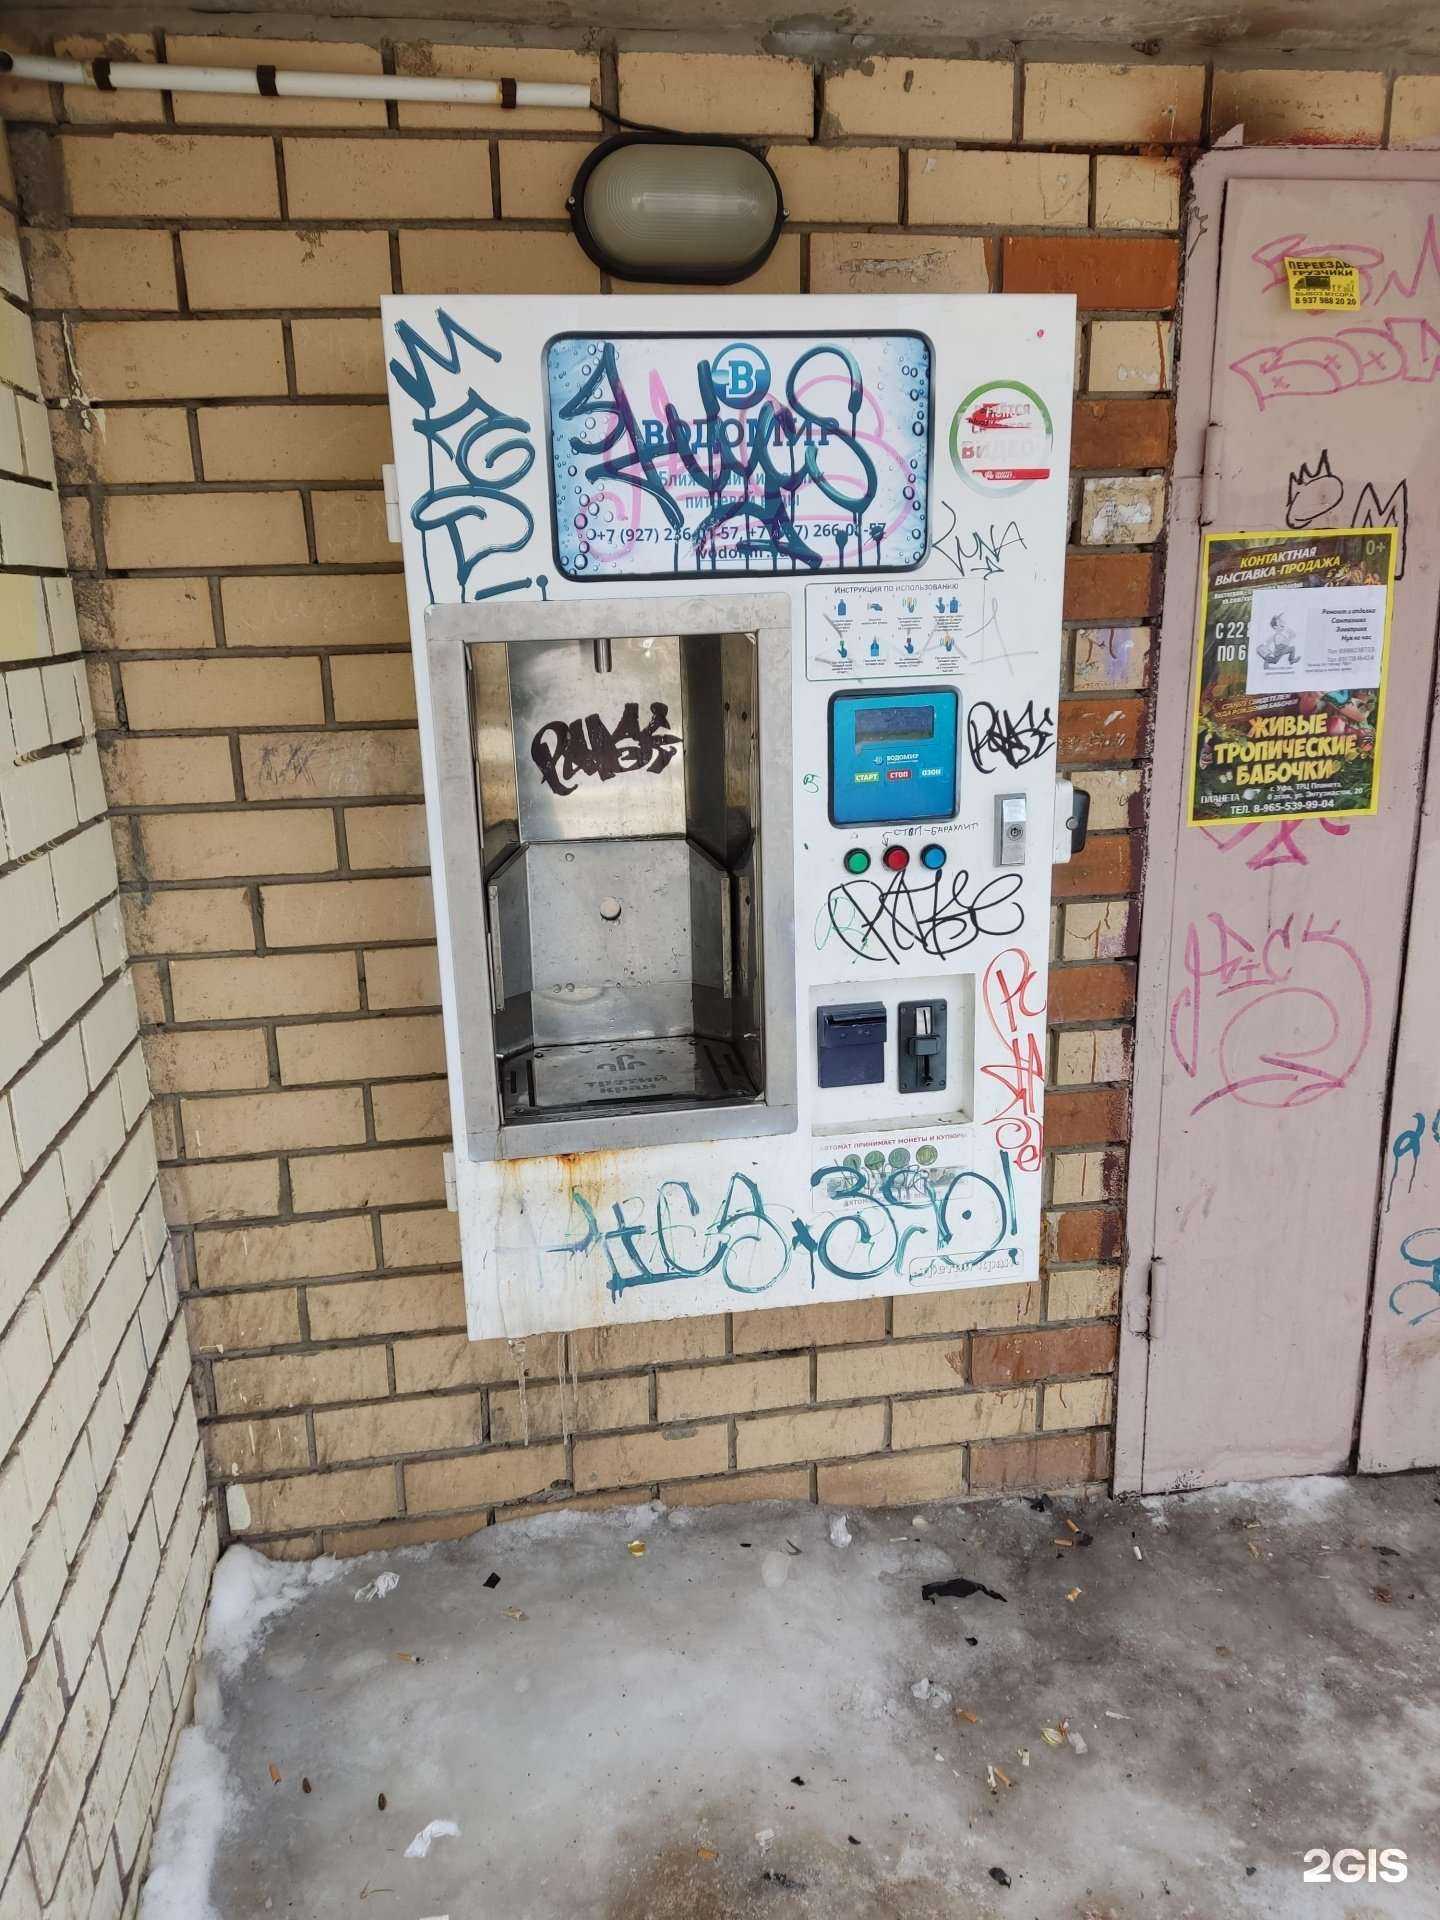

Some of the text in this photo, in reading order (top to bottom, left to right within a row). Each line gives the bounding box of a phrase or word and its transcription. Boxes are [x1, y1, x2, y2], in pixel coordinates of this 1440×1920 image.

[1303, 296, 1318, 304] 937
[1335, 297, 1345, 305] 20
[1346, 297, 1357, 306] 20
[620, 528, 659, 543] (927)
[1240, 546, 1317, 569] КОНТАКТНАЯ
[1215, 555, 1342, 587] ВЫСТАВКА-ПРОДАЖА
[1215, 622, 1244, 639] С 22
[1217, 644, 1247, 662] ПО 6
[1249, 713, 1328, 738] ЖИВЫЕ
[1214, 734, 1358, 765] ТРОПИЧЕСКИЕ
[856, 773, 877, 781] СТАРТ
[889, 771, 909, 779] СТОП
[921, 768, 942, 776] ОЗОН
[1236, 759, 1334, 786] БАБОЧКИ
[1253, 799, 1336, 813] 8-965-539-99-04
[898, 1136, 928, 1145] МОНЕТЫ
